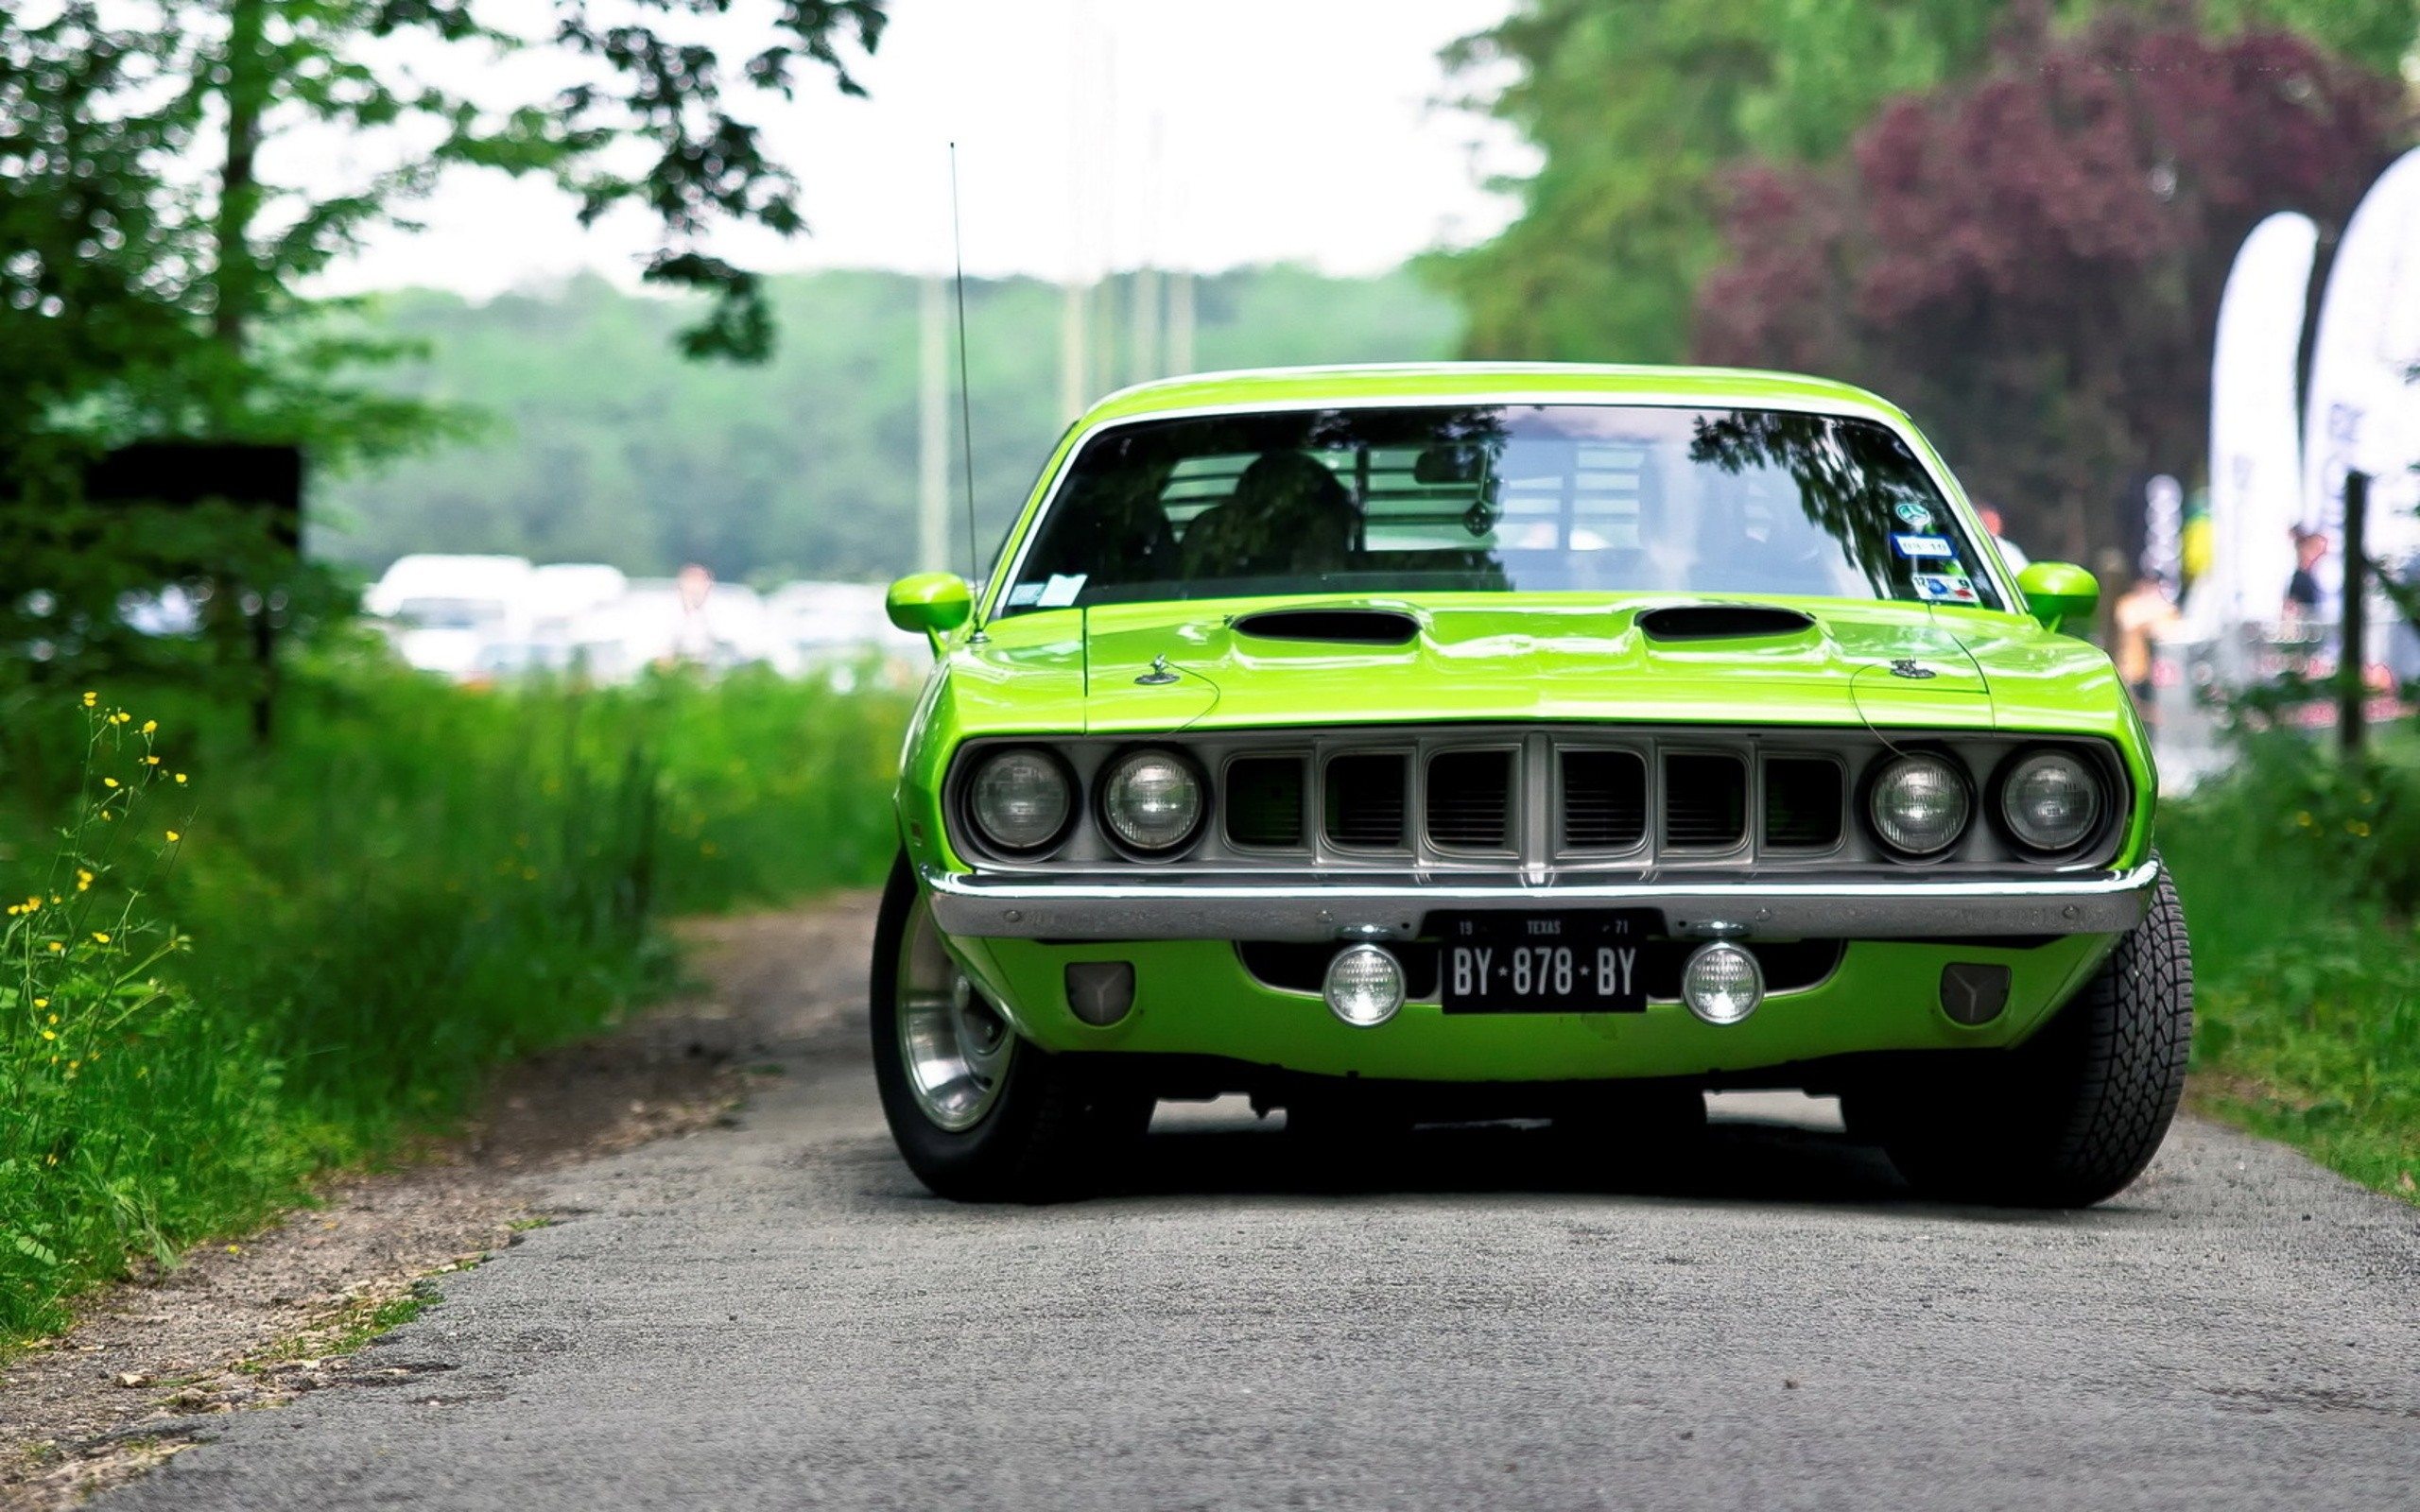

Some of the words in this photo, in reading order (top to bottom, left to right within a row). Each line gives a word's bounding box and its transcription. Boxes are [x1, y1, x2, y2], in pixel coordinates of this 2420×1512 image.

[1459, 920, 1473, 936] 19
[1527, 919, 1561, 936] TEXAS
[1615, 919, 1629, 935] 71
[1454, 948, 1492, 996] BY
[1513, 947, 1572, 995] 878
[1598, 948, 1635, 996] BY
